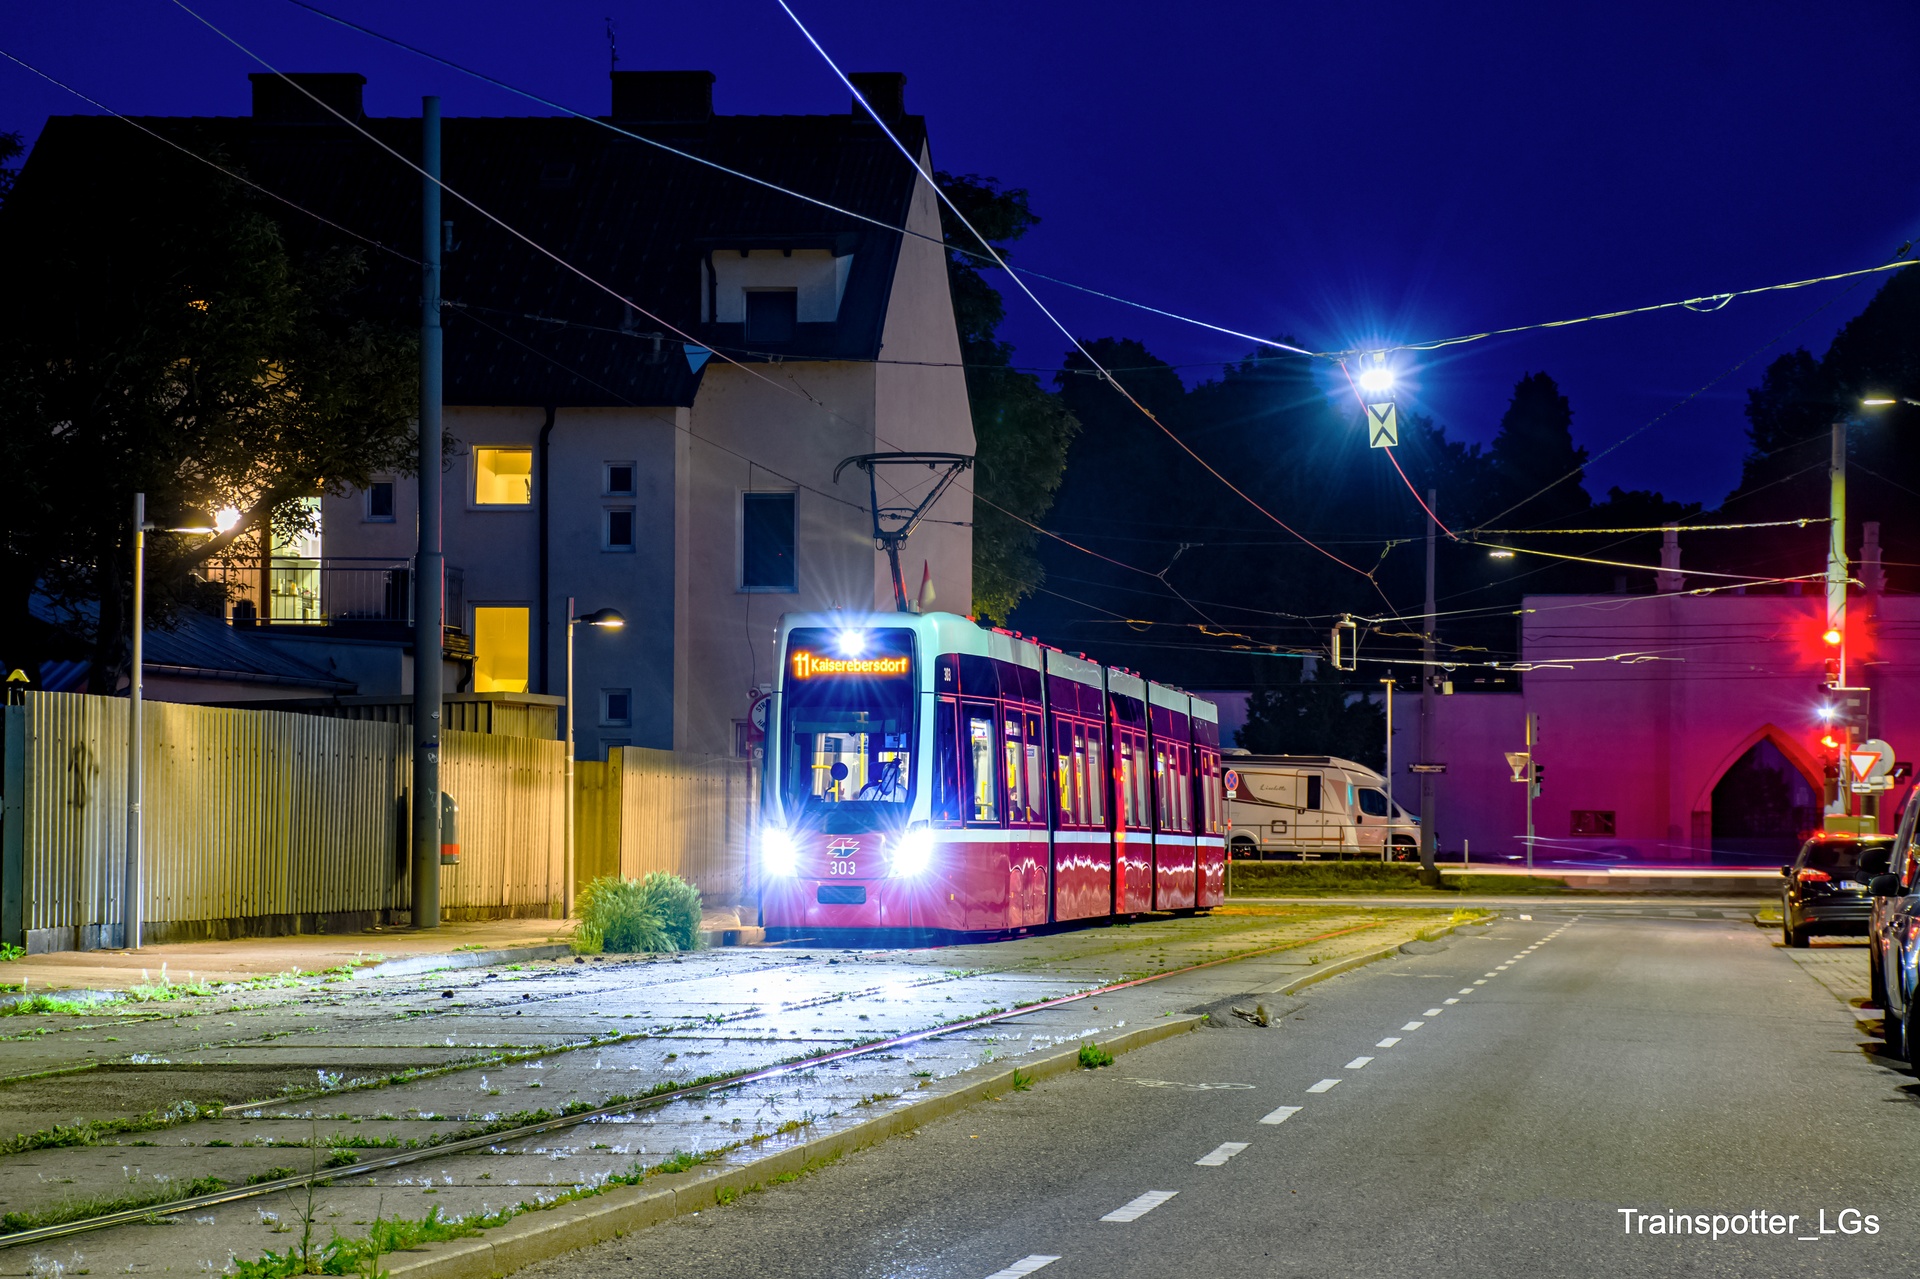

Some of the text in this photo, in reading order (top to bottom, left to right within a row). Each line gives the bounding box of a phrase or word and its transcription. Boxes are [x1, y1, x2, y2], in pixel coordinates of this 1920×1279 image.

[794, 653, 907, 677] 11 Kaiserebersdorf
[829, 860, 856, 875] 303
